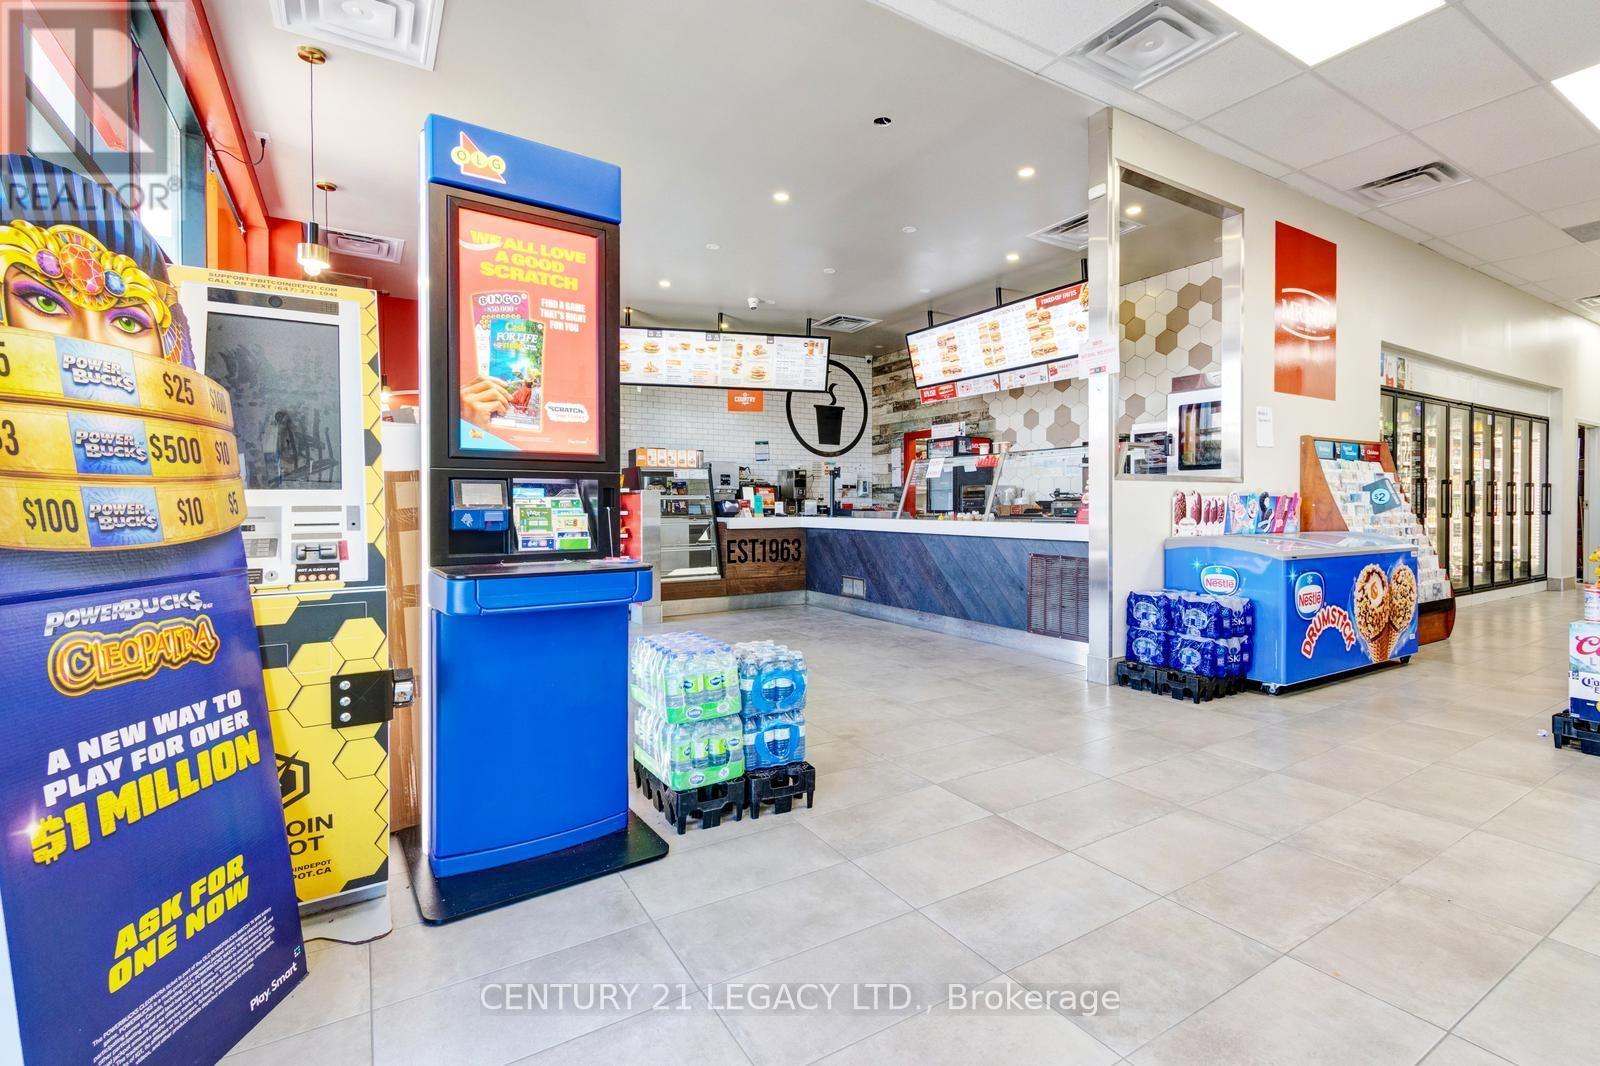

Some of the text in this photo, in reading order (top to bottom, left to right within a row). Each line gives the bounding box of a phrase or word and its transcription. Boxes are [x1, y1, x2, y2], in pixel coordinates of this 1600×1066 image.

[454, 148, 503, 172] OLG
[470, 231, 587, 264] WE ALL LOVE
[495, 251, 565, 273] A GOOD
[208, 277, 231, 285] CALL
[250, 282, 272, 291] TEXT
[480, 262, 578, 290] SCRATCH
[479, 294, 521, 305] BINGO
[62, 354, 122, 374] POWER
[163, 372, 195, 406] $25
[547, 406, 585, 414] SCRATCH
[75, 430, 135, 446] POWER
[149, 433, 202, 465] $500
[215, 441, 230, 465] $10
[89, 503, 149, 519] POWER
[177, 497, 204, 526] $10
[228, 492, 238, 515] $5
[1374, 492, 1386, 502] $2
[22, 497, 79, 533] $100
[1302, 605, 1356, 659] DRUMSTICK
[49, 616, 218, 694] CLEOPATRA
[47, 689, 242, 775] A NEW WAY TO
[43, 710, 249, 807] PLAY FOR OVER
[30, 730, 260, 865] $1 MILLION
[114, 854, 244, 960] ASK FOR
[107, 875, 249, 994] ONE NOW
[271, 961, 298, 992] Smart
